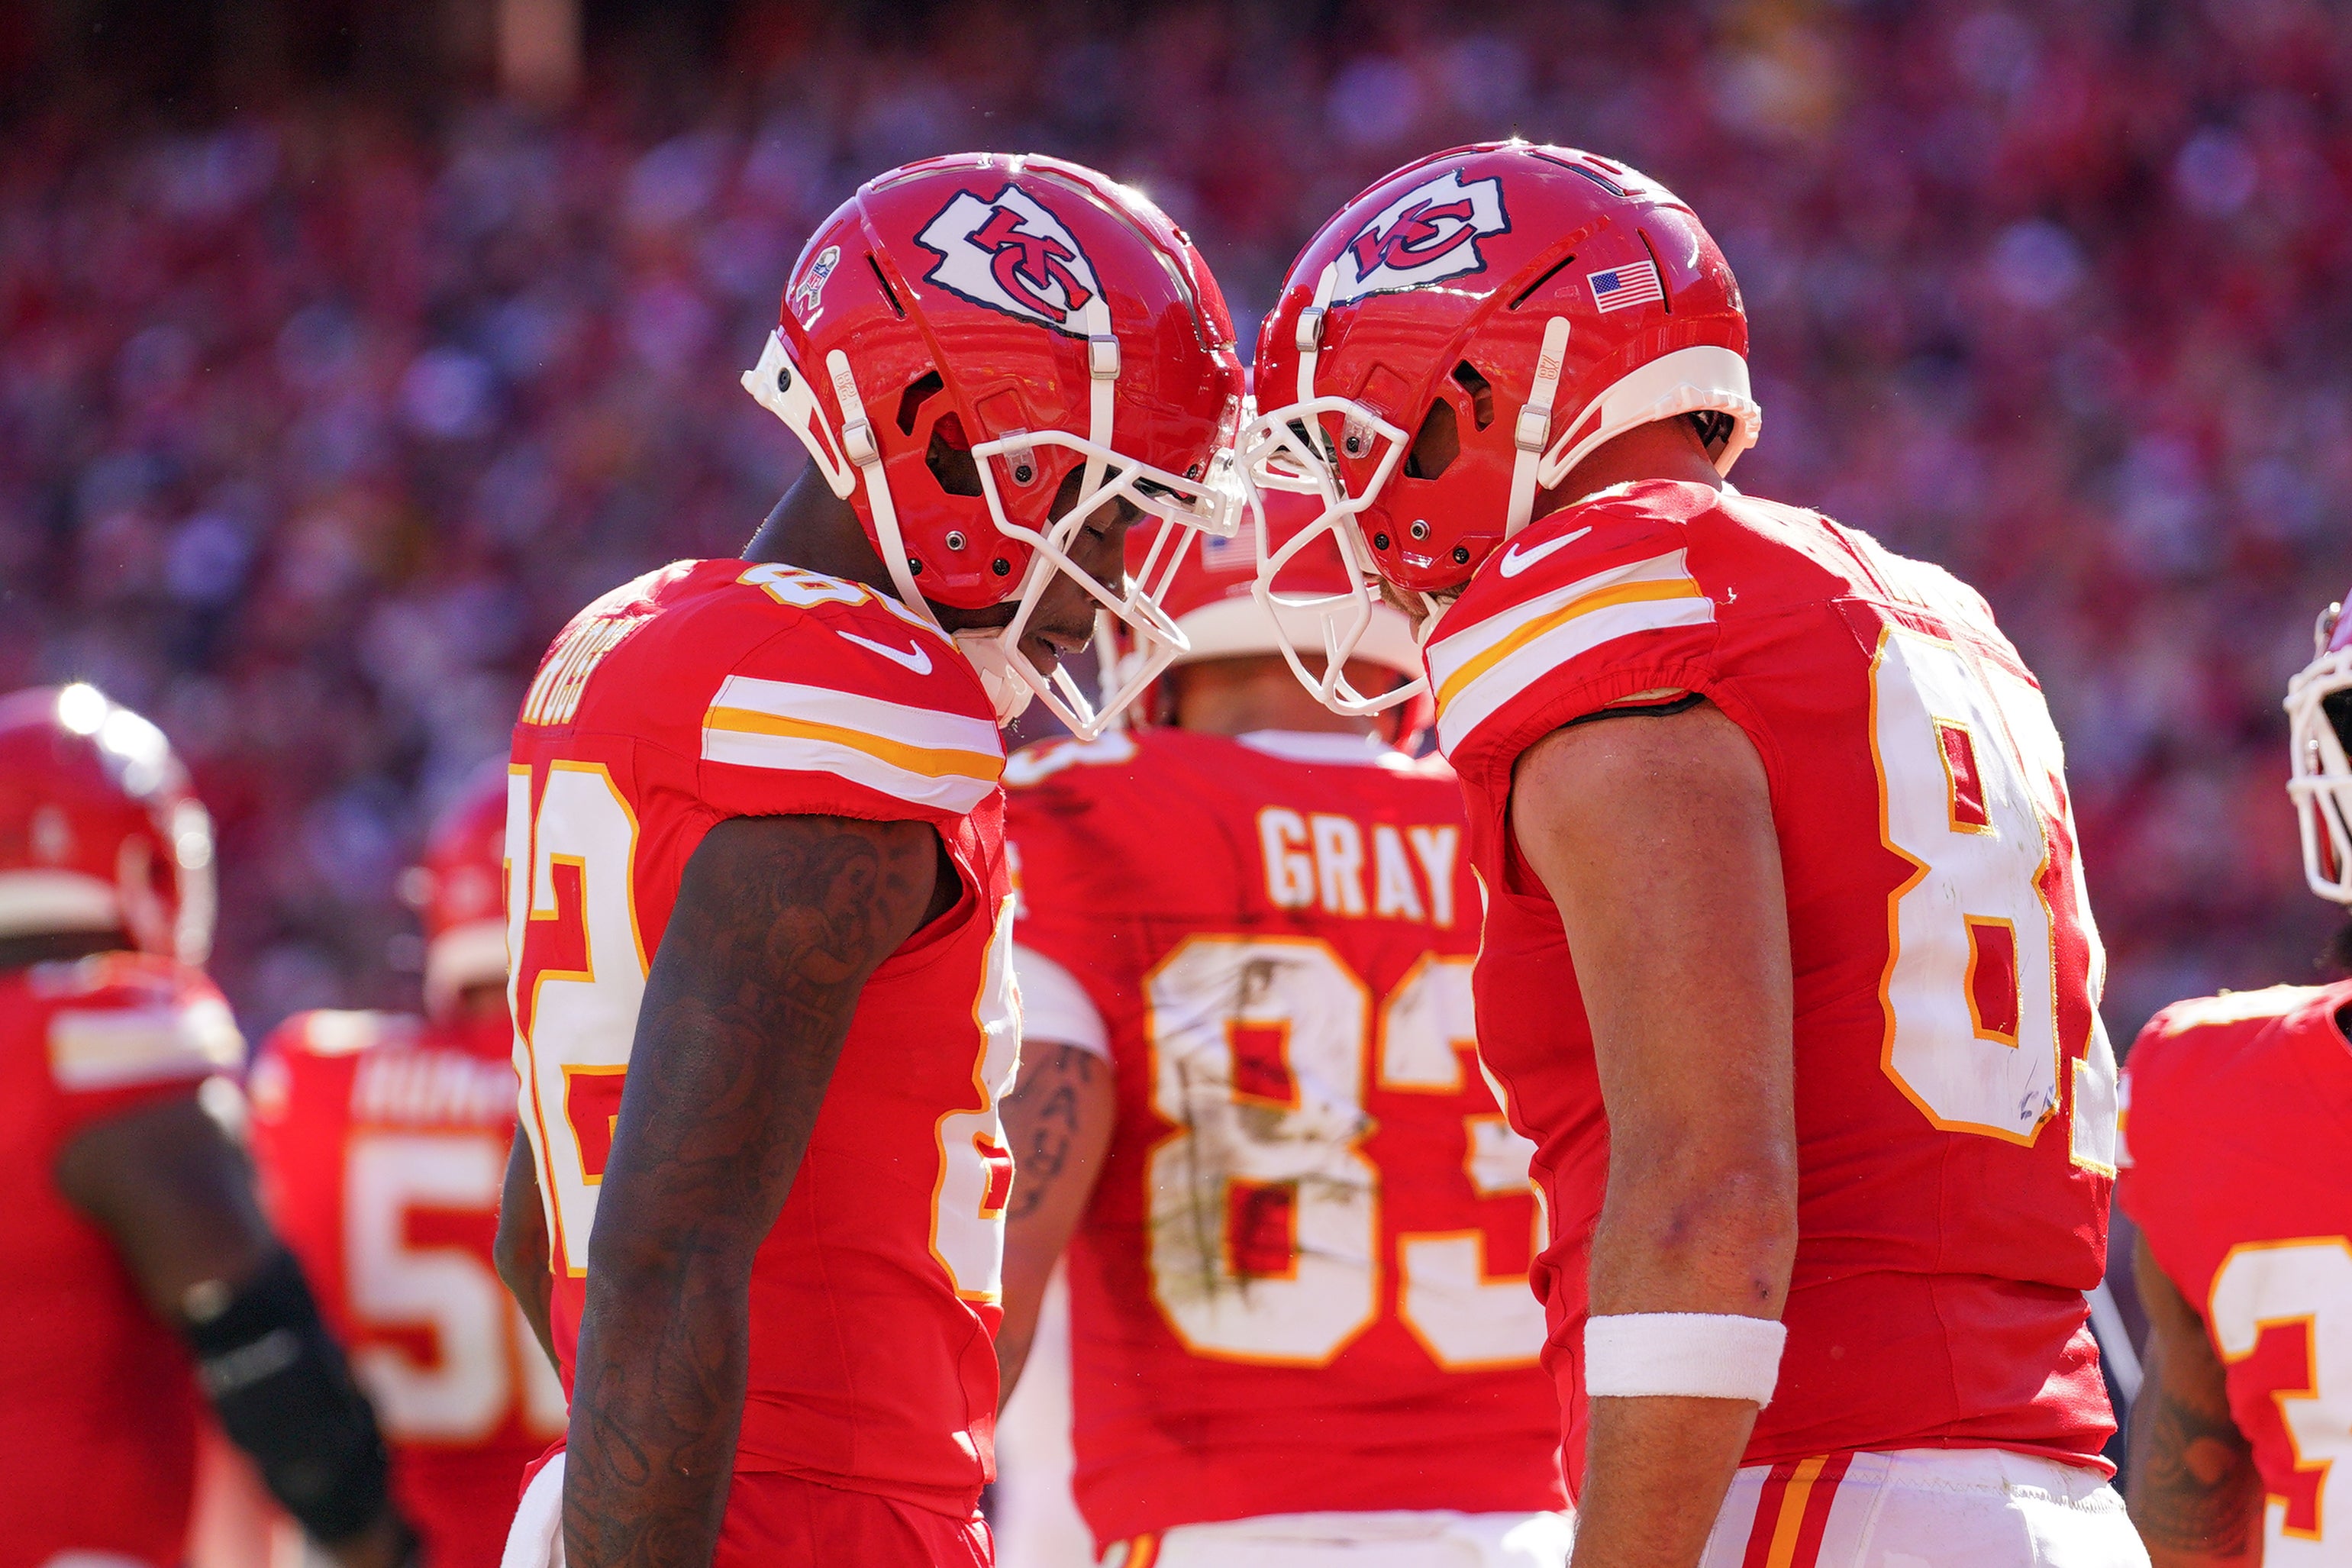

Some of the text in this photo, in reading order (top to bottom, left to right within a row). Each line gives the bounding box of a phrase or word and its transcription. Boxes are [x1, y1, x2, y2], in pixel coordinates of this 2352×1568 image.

[963, 205, 1093, 324] KC
[1348, 197, 1479, 284] KC
[1537, 353, 1560, 380] 87
[1255, 804, 1460, 929] GRAY
[1142, 933, 1551, 1372] 83
[345, 1125, 569, 1444] 5
